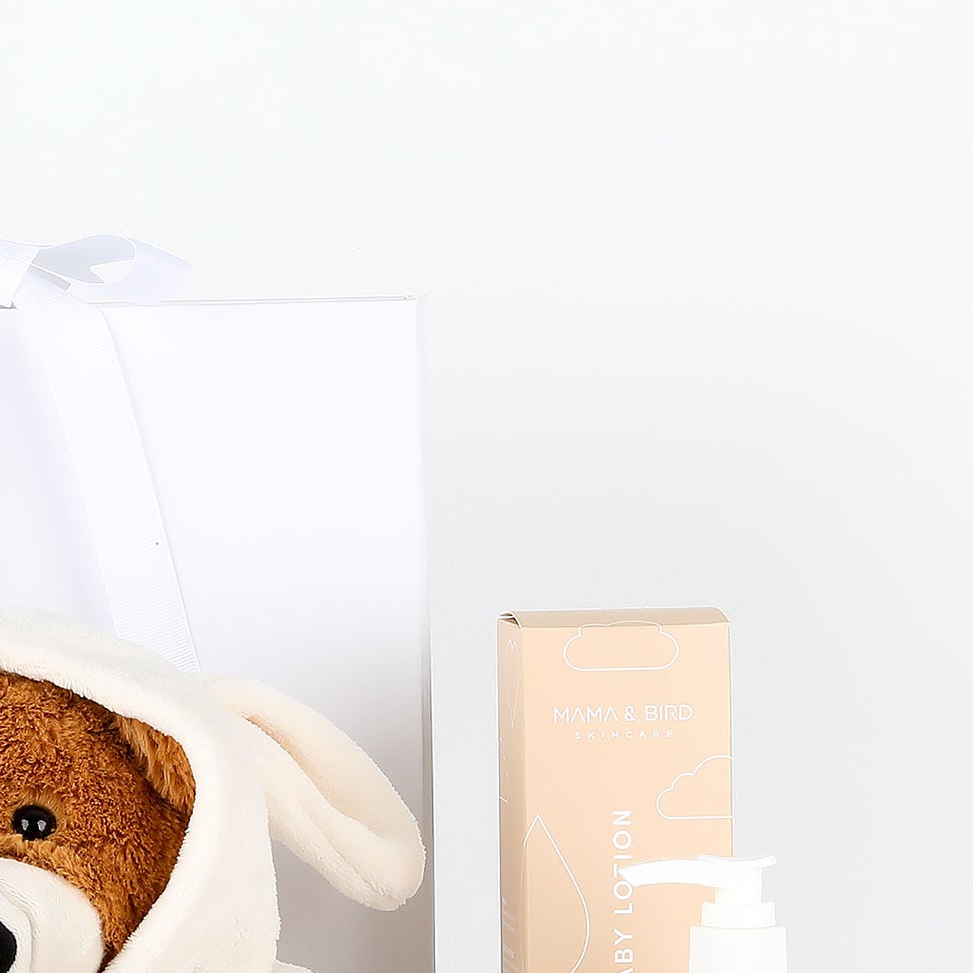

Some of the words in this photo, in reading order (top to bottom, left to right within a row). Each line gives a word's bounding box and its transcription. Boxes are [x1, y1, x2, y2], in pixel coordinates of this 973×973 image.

[553, 705, 619, 724] MAMA
[624, 705, 637, 722] &
[645, 704, 694, 721] BIRD
[574, 729, 674, 740] SKINCARE
